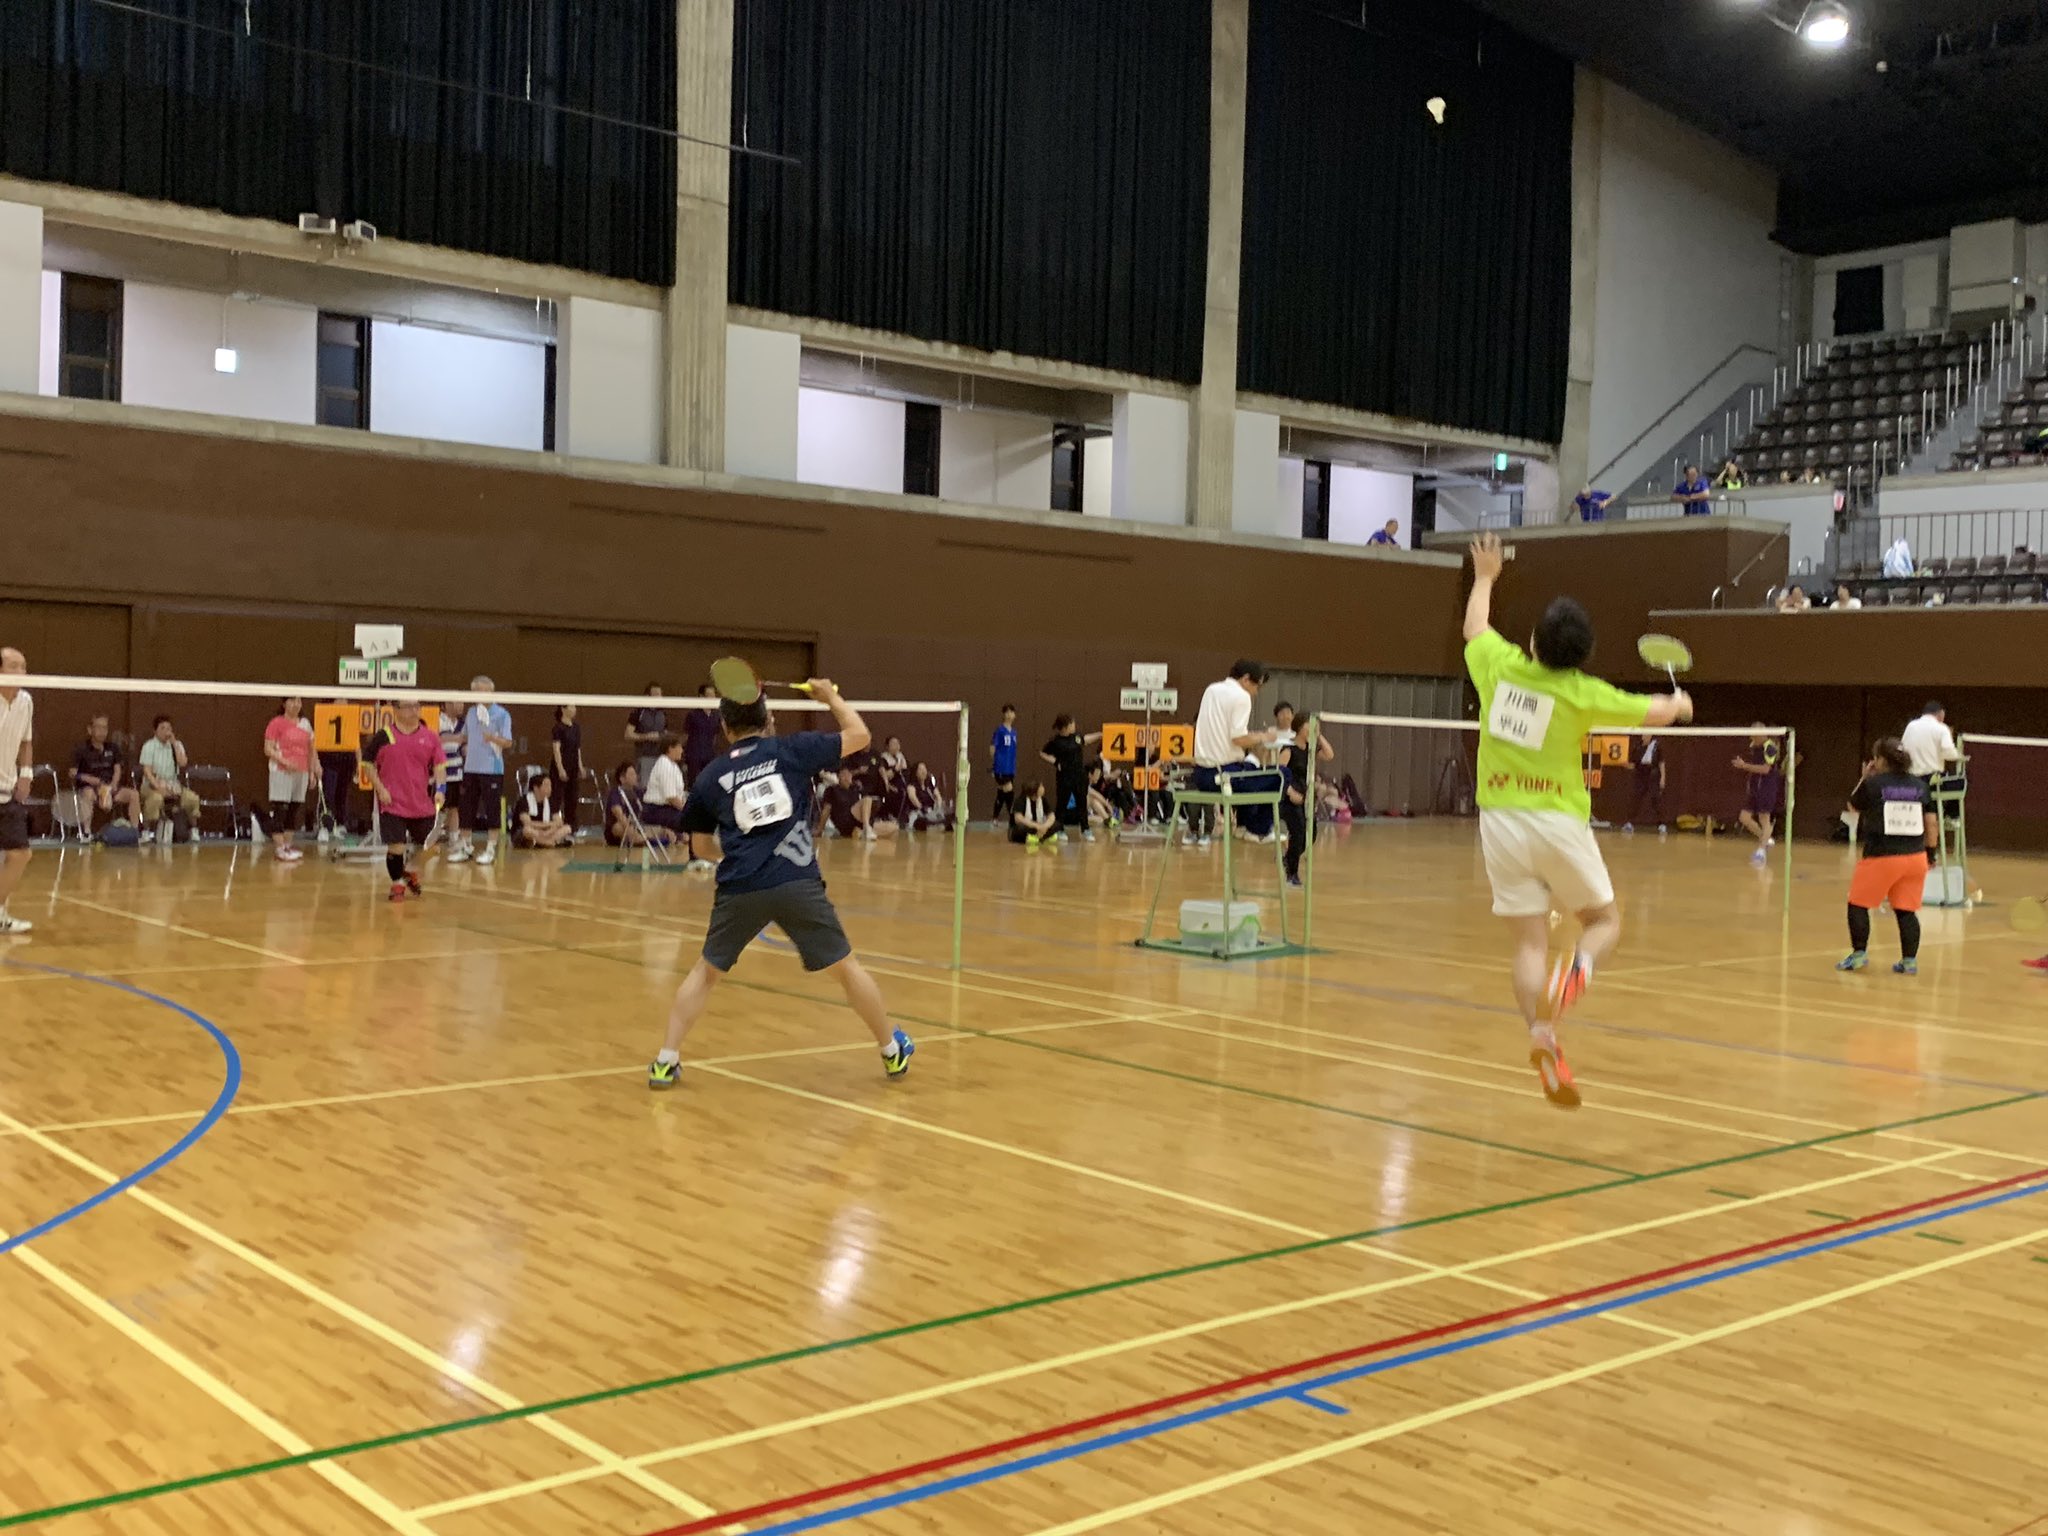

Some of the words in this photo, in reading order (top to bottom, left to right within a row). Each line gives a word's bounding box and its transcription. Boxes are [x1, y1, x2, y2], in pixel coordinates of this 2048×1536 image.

[362, 710, 372, 729] 0
[328, 715, 343, 745] 1
[1137, 730, 1144, 742] 0
[1110, 733, 1128, 756] 4
[1169, 734, 1185, 757] 3
[1609, 743, 1622, 760] 8
[1137, 772, 1143, 787] 1
[1149, 771, 1158, 788] 0
